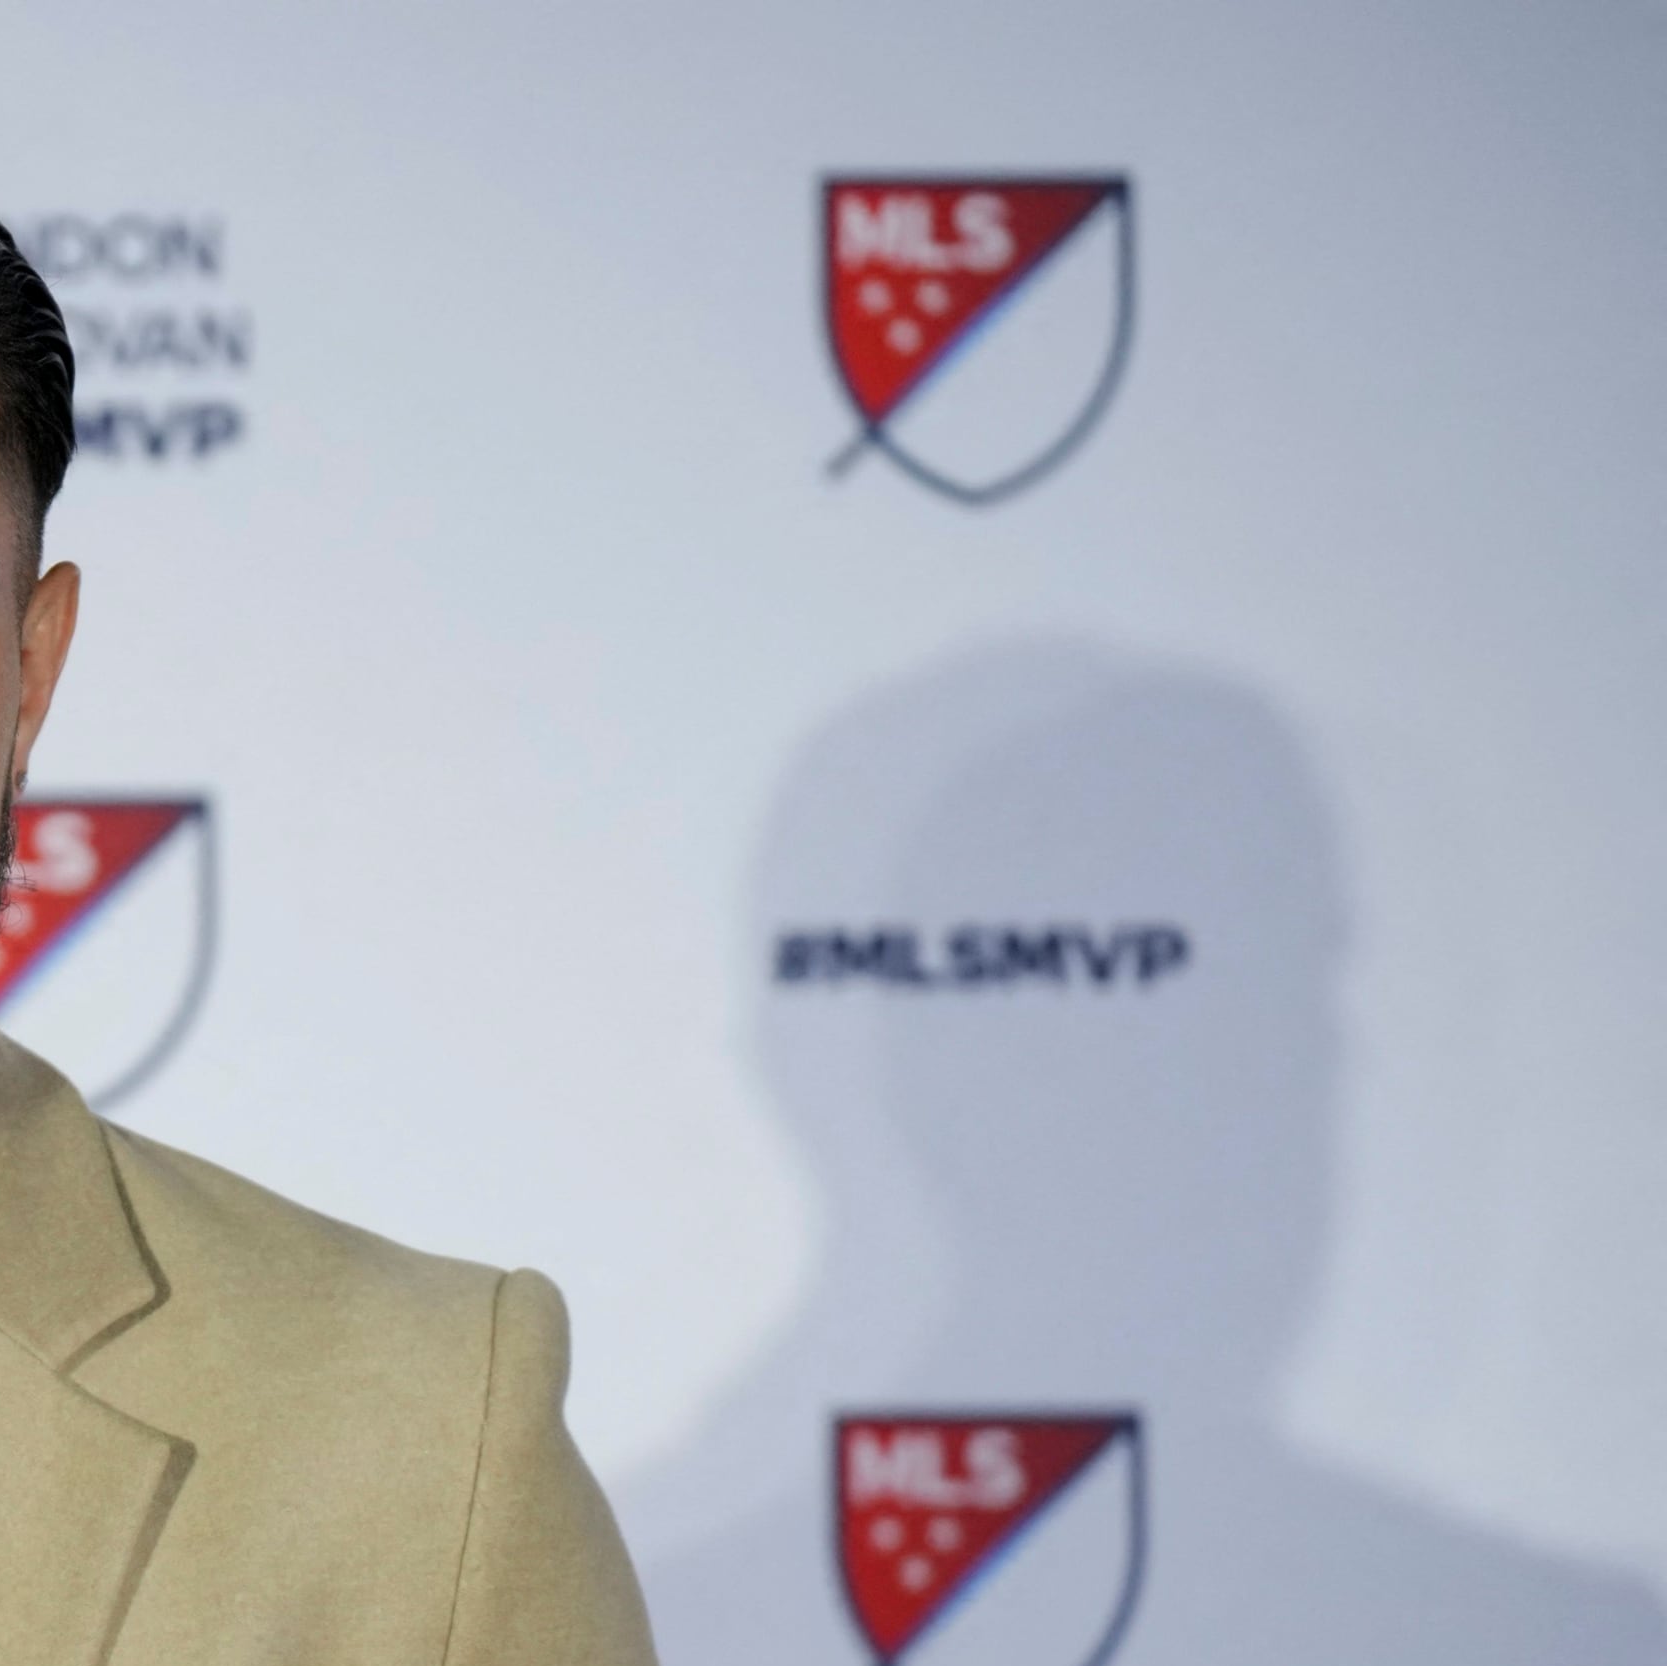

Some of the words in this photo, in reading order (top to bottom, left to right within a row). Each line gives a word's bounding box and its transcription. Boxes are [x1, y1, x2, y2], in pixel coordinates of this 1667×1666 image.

[837, 193, 1013, 270] MLS
[775, 926, 1190, 988] #MLSMVP
[848, 1427, 1024, 1509] MLS
